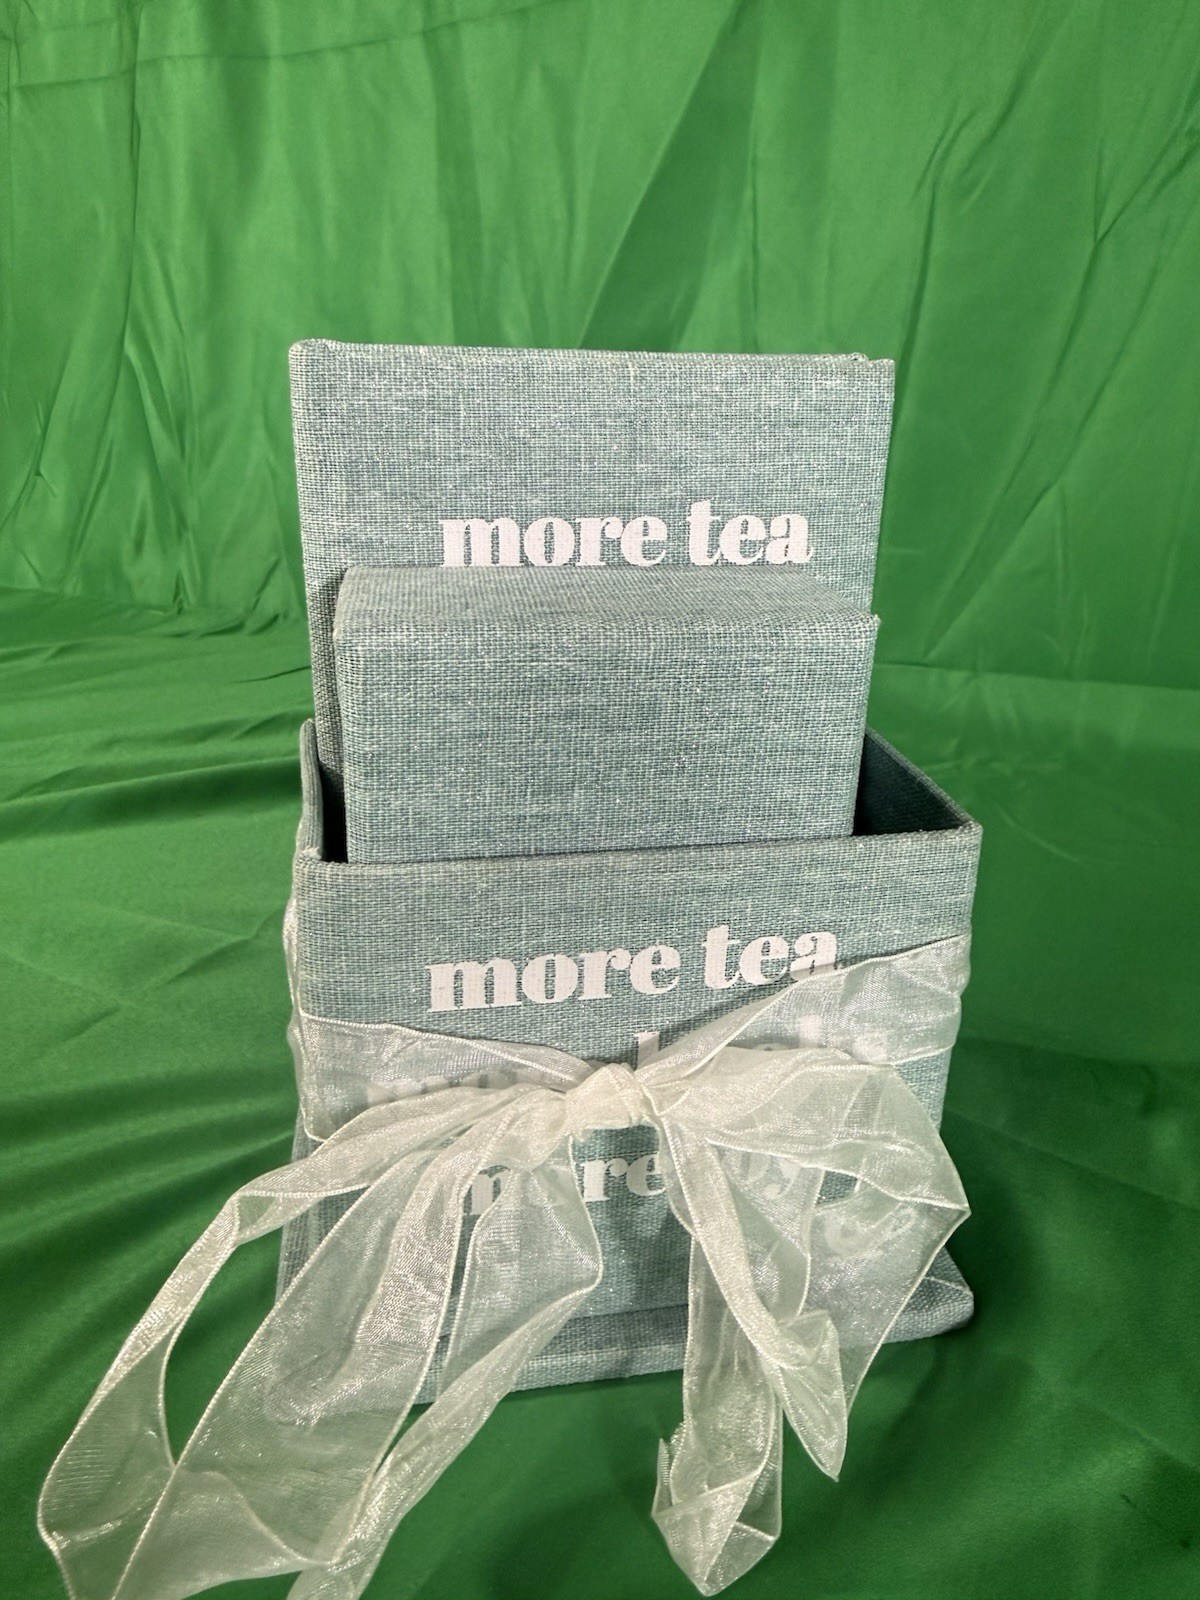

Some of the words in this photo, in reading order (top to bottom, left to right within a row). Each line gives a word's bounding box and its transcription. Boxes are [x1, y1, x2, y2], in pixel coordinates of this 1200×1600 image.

[439, 515, 668, 567] more
[688, 499, 813, 566] tea
[424, 943, 681, 1012] more
[702, 924, 839, 990] tea
